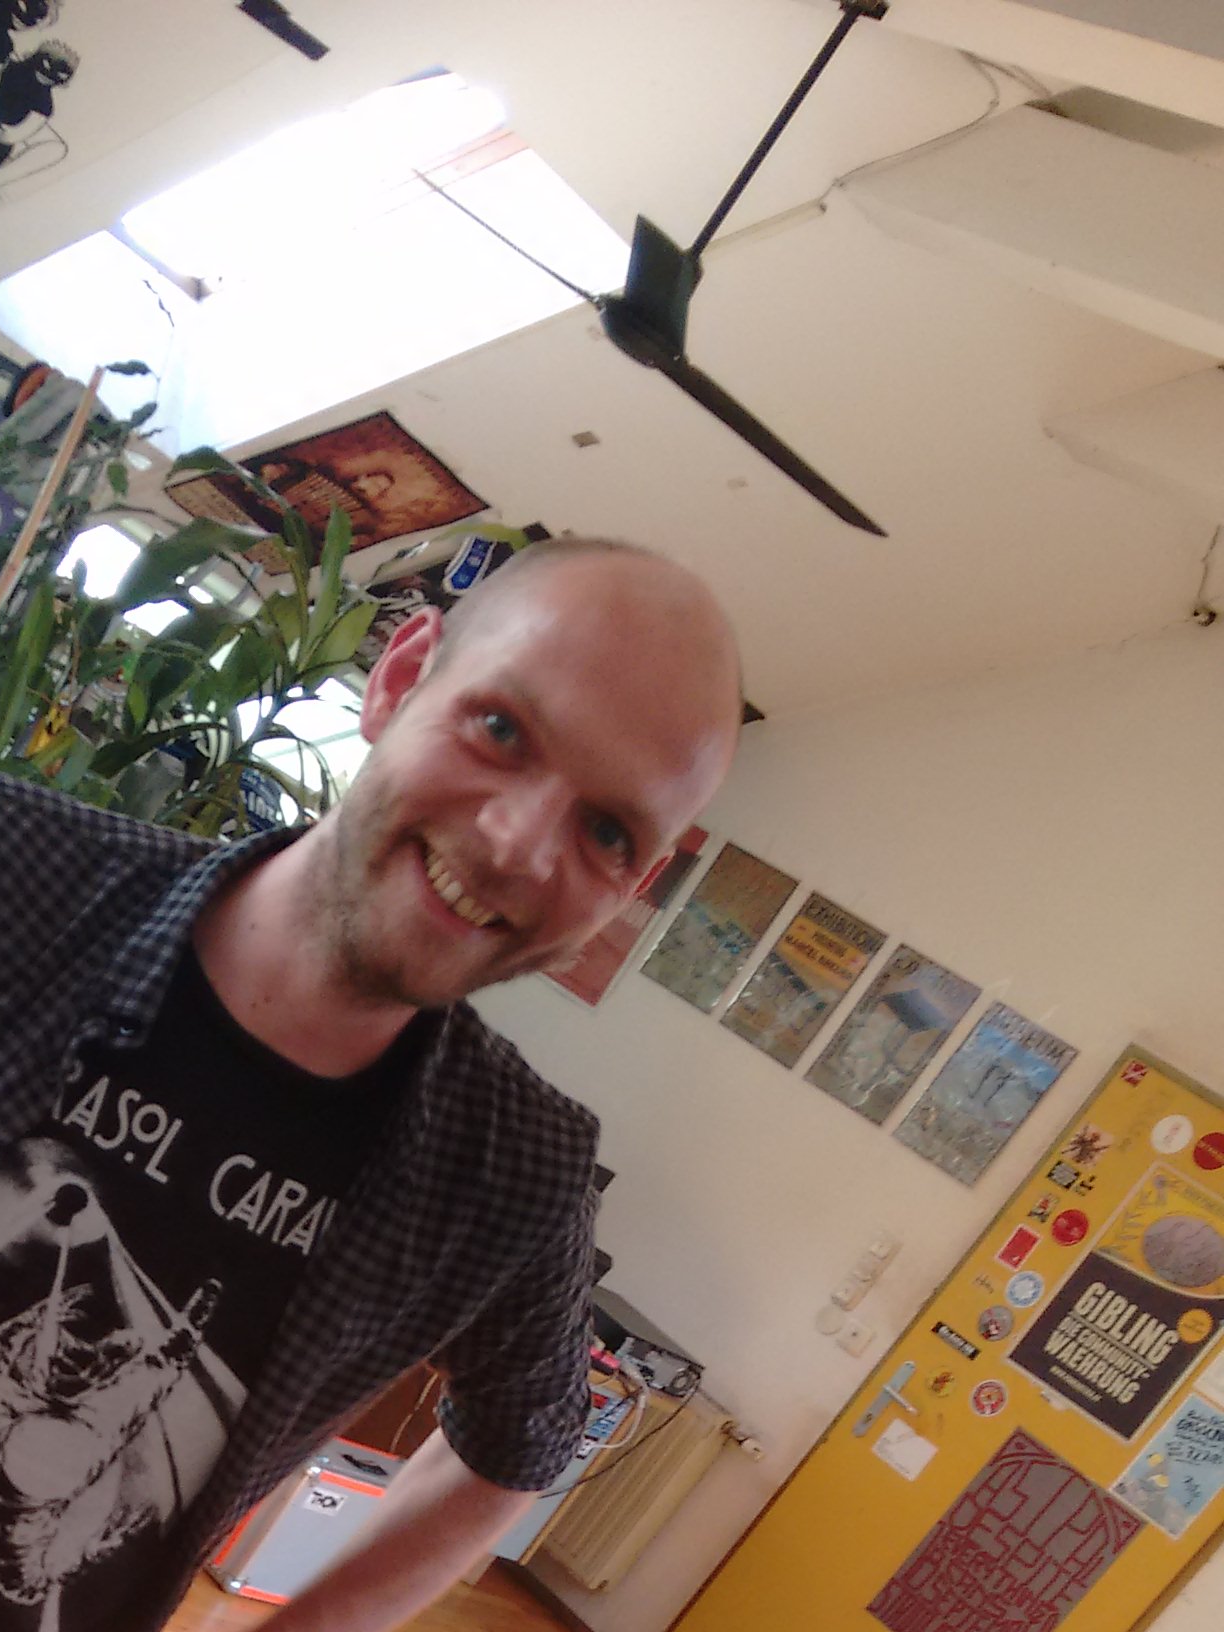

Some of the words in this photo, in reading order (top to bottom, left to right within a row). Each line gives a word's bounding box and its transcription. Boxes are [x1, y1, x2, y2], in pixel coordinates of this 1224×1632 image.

[209, 1153, 338, 1257] CARA
[1044, 1330, 1141, 1403] WAEHRUNG
[1074, 1281, 1179, 1364] GIBLING
[950, 1491, 1085, 1601] DESPITE
